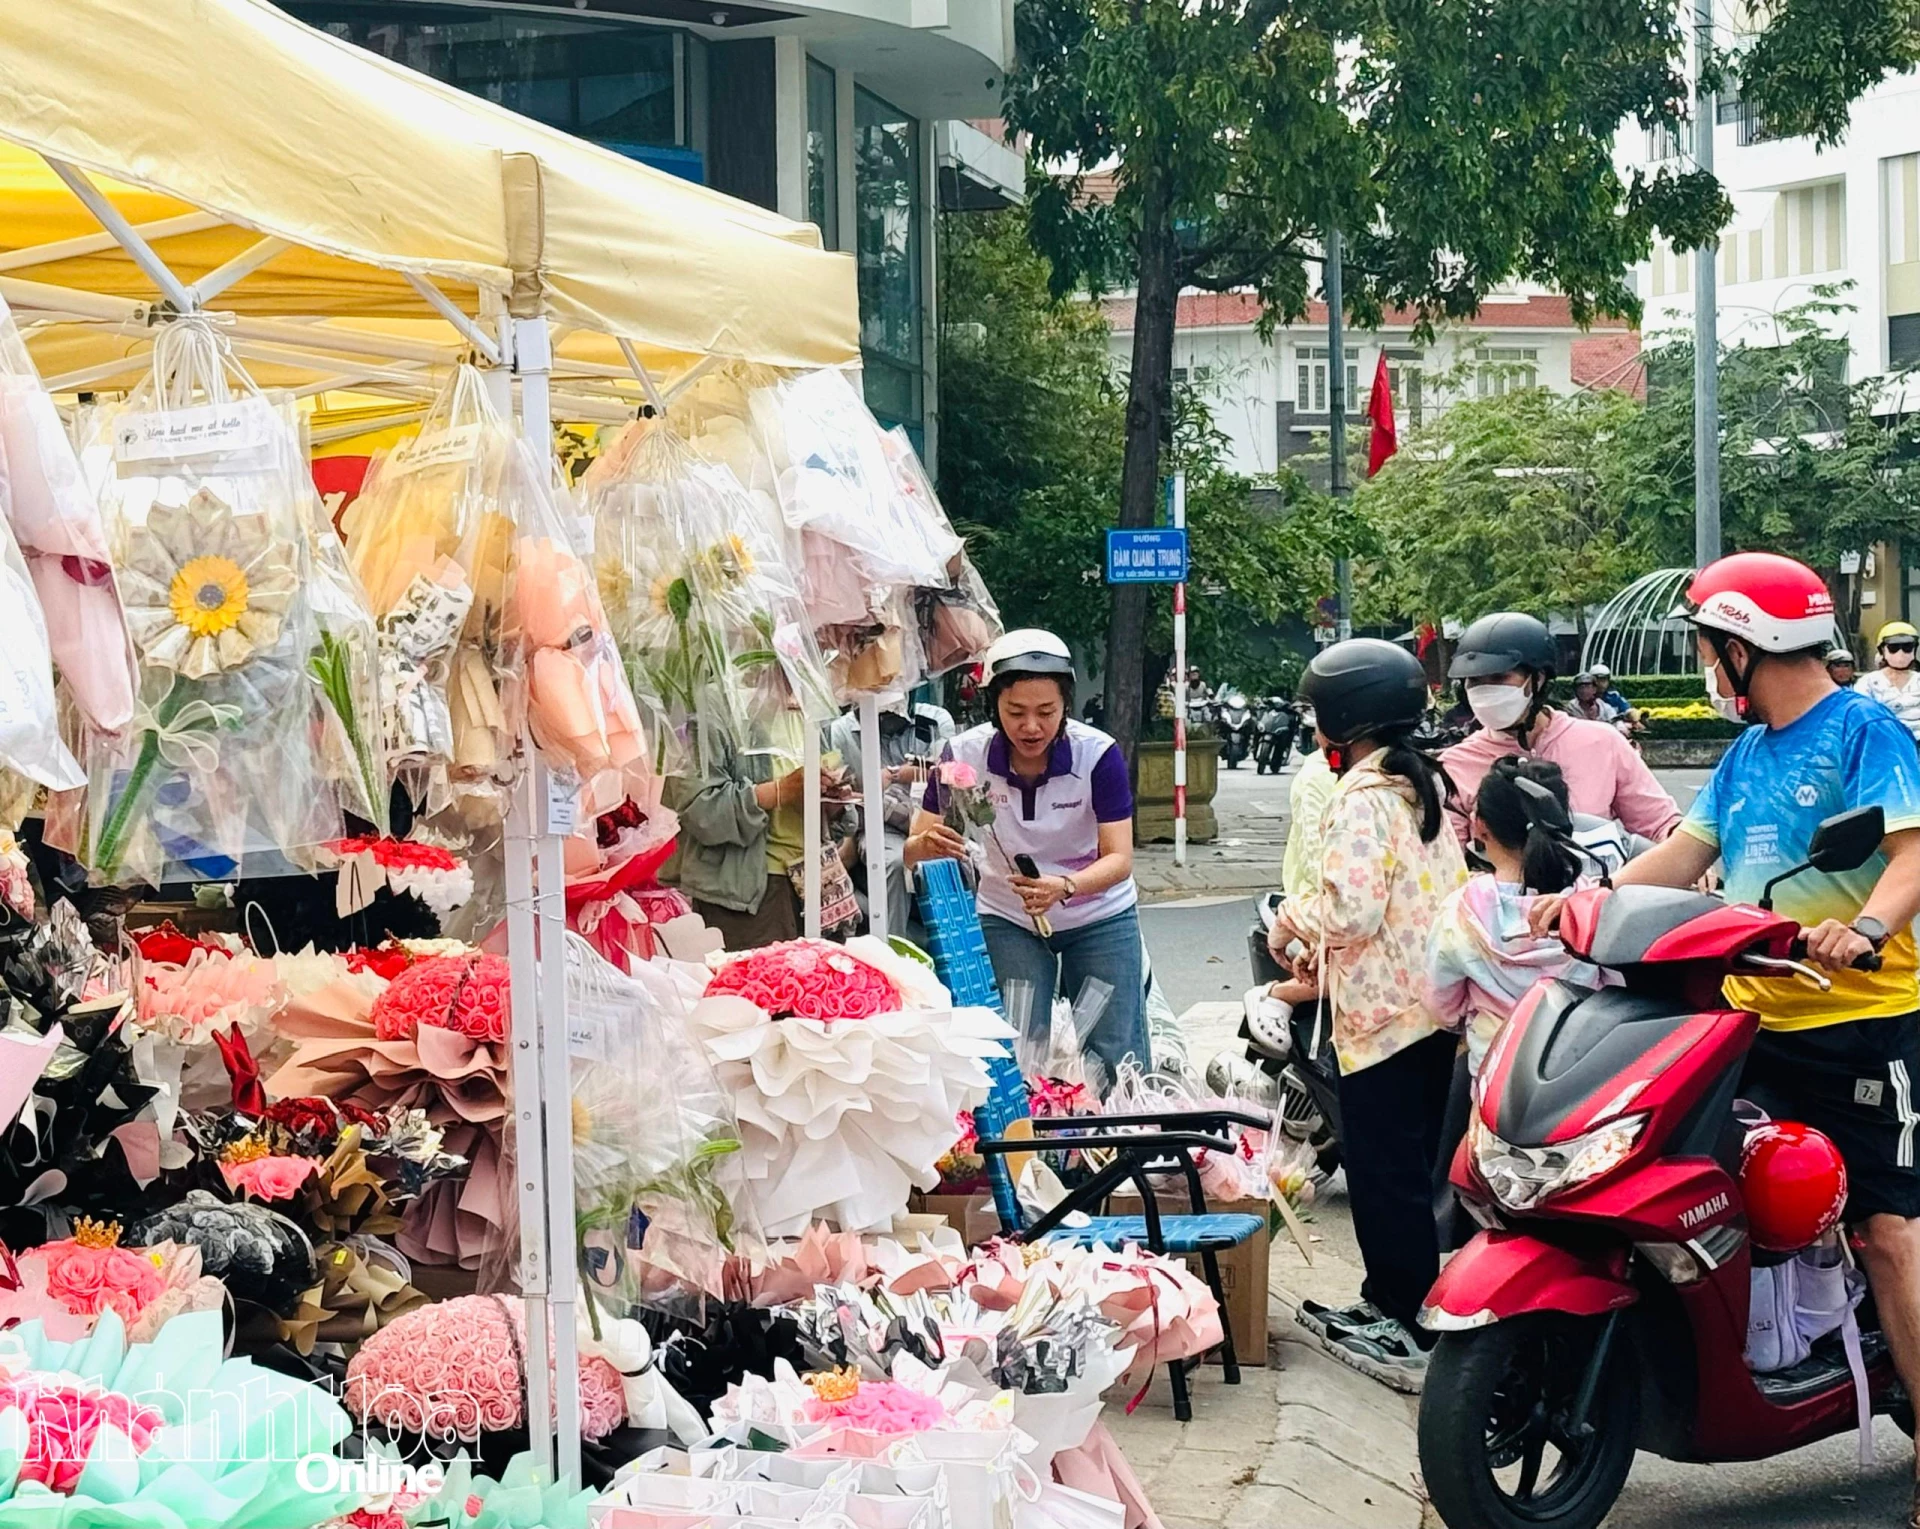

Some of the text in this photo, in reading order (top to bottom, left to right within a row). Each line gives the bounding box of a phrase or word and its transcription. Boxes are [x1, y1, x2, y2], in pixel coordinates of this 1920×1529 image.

[1132, 548, 1156, 568] QUANG
[1157, 548, 1181, 567] TRUNG
[1678, 1191, 1730, 1229] YAMAHA
